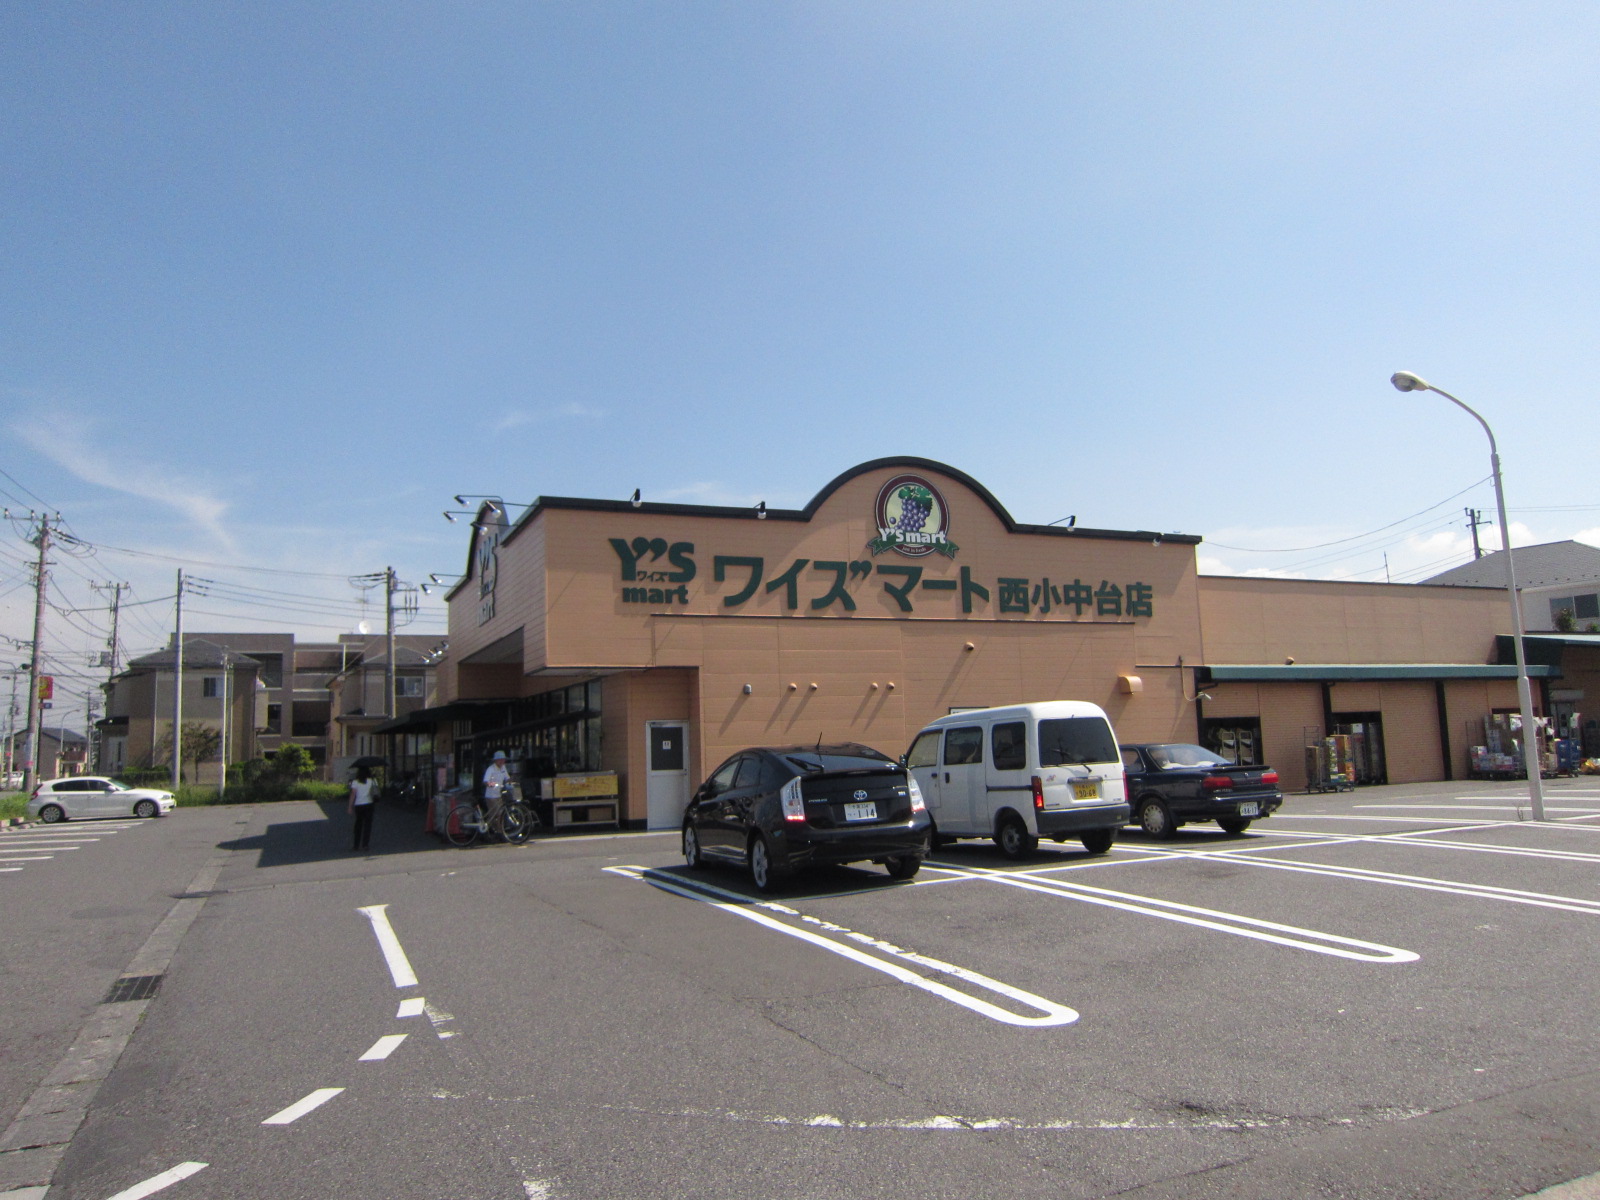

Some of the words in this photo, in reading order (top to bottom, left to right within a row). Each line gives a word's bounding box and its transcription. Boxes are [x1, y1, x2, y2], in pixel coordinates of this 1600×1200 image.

[905, 531, 946, 543] mart
[637, 571, 669, 582] ワイズ
[713, 555, 990, 614] ワイズマート
[997, 577, 1153, 617] 西小中台店
[622, 584, 689, 605] mart
